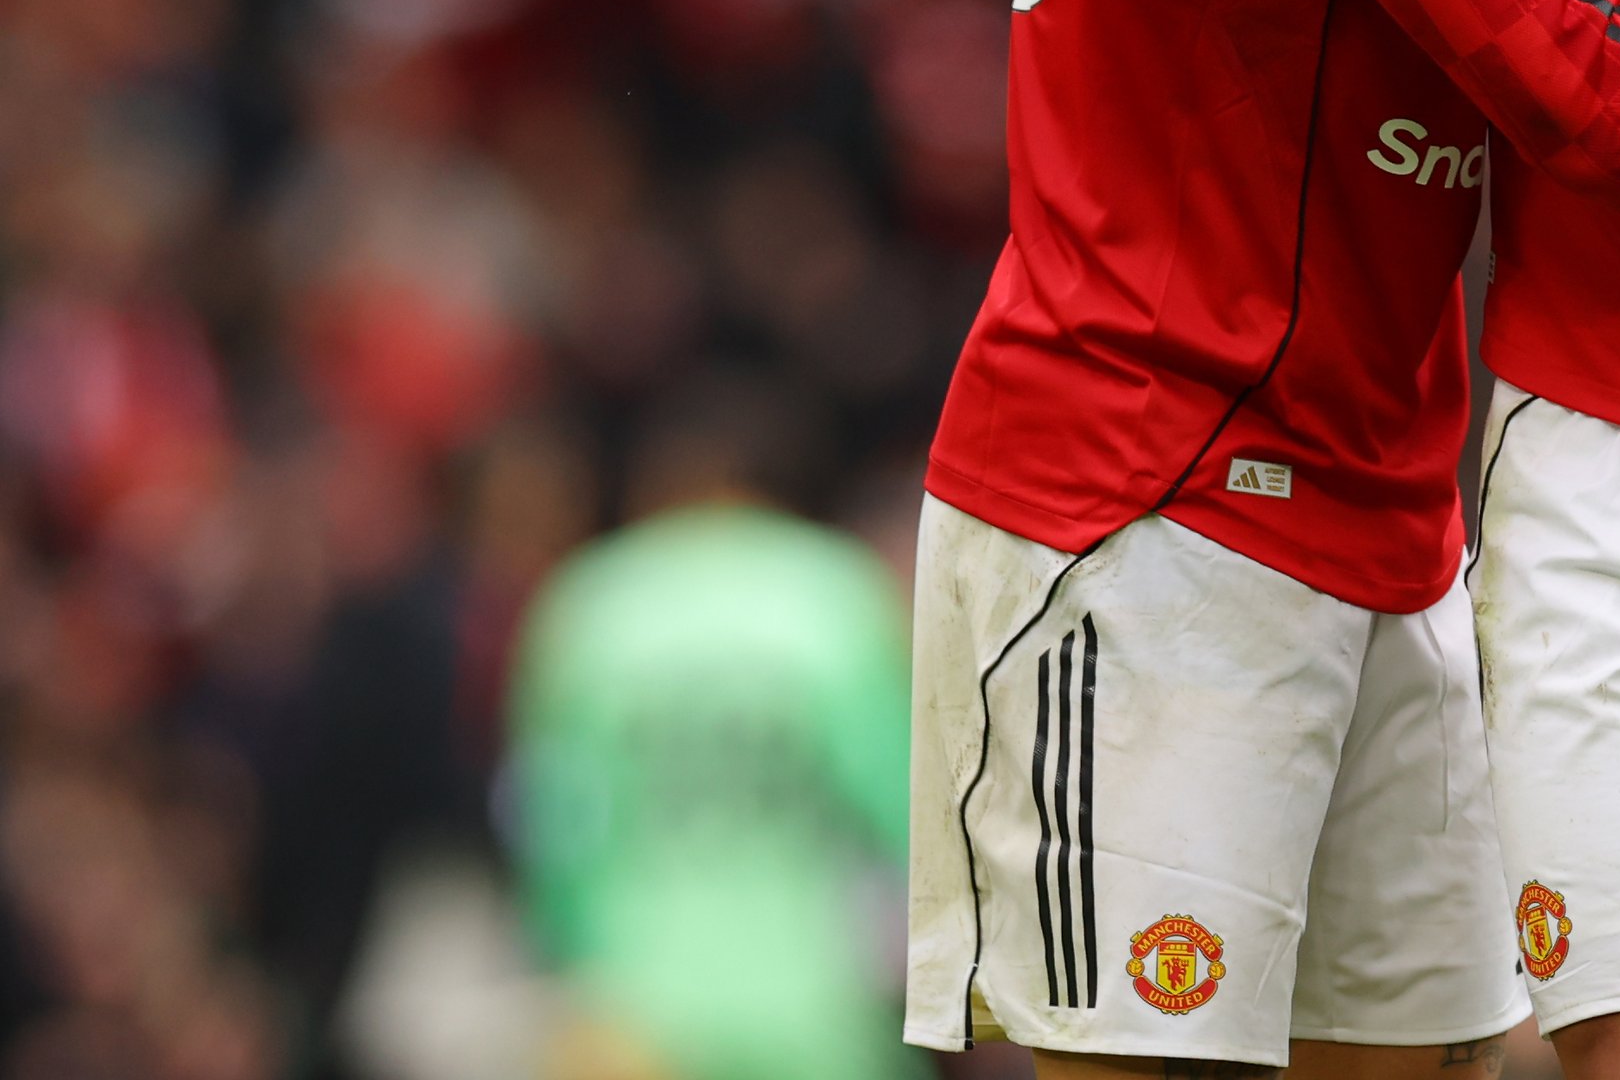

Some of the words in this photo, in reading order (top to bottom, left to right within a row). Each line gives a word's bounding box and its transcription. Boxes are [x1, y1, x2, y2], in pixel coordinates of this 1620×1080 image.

[1138, 922, 1216, 955] MANCHESTER
[1530, 952, 1561, 973] UNITED
[1148, 990, 1203, 1007] UNITED
